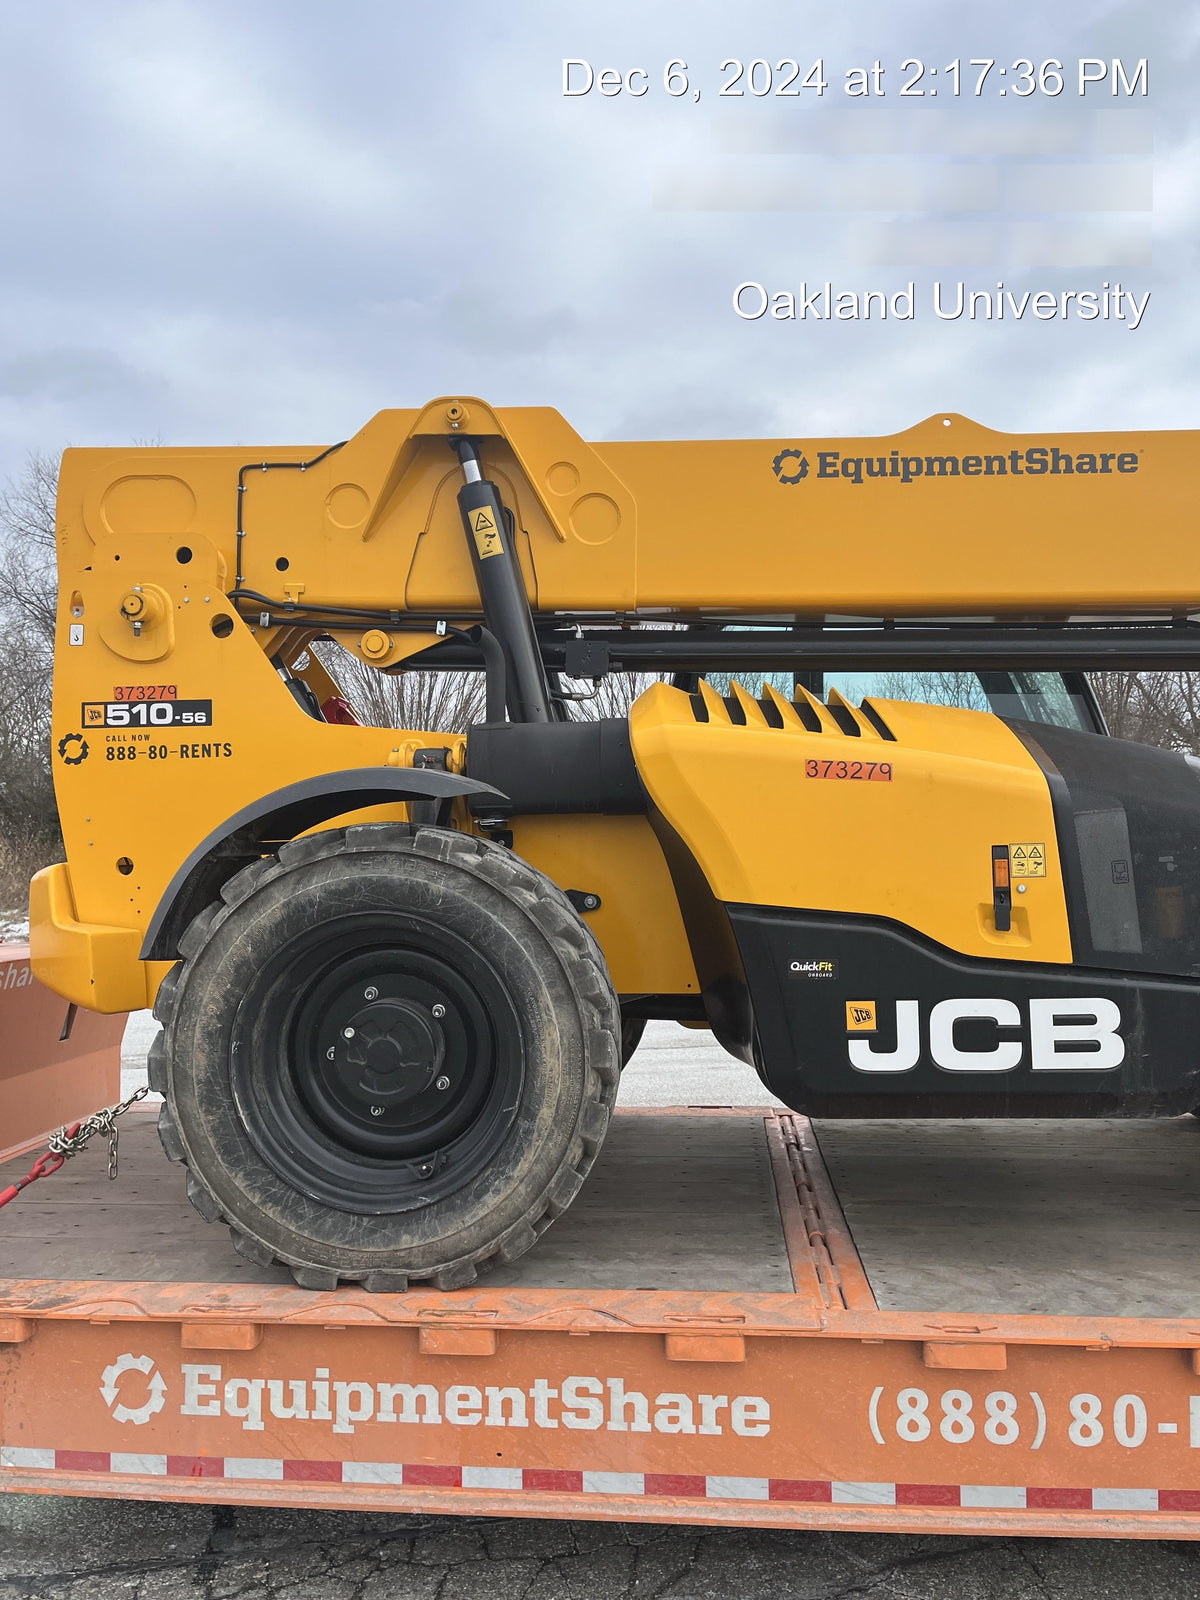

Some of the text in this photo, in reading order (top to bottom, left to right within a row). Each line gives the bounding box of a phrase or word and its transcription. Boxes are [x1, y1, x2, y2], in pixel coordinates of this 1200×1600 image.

[817, 447, 1139, 484] EquipmentShare
[114, 685, 178, 701] 373279
[106, 702, 207, 726] 510-56
[105, 733, 151, 743] CALL NOW
[105, 742, 233, 761] 888-80-RENTS
[806, 760, 892, 781] 373279
[790, 961, 833, 971] QuickFit
[848, 998, 1125, 1072] JCB
[180, 1363, 771, 1436] EquipmentShare
[868, 1386, 1047, 1450] (888)
